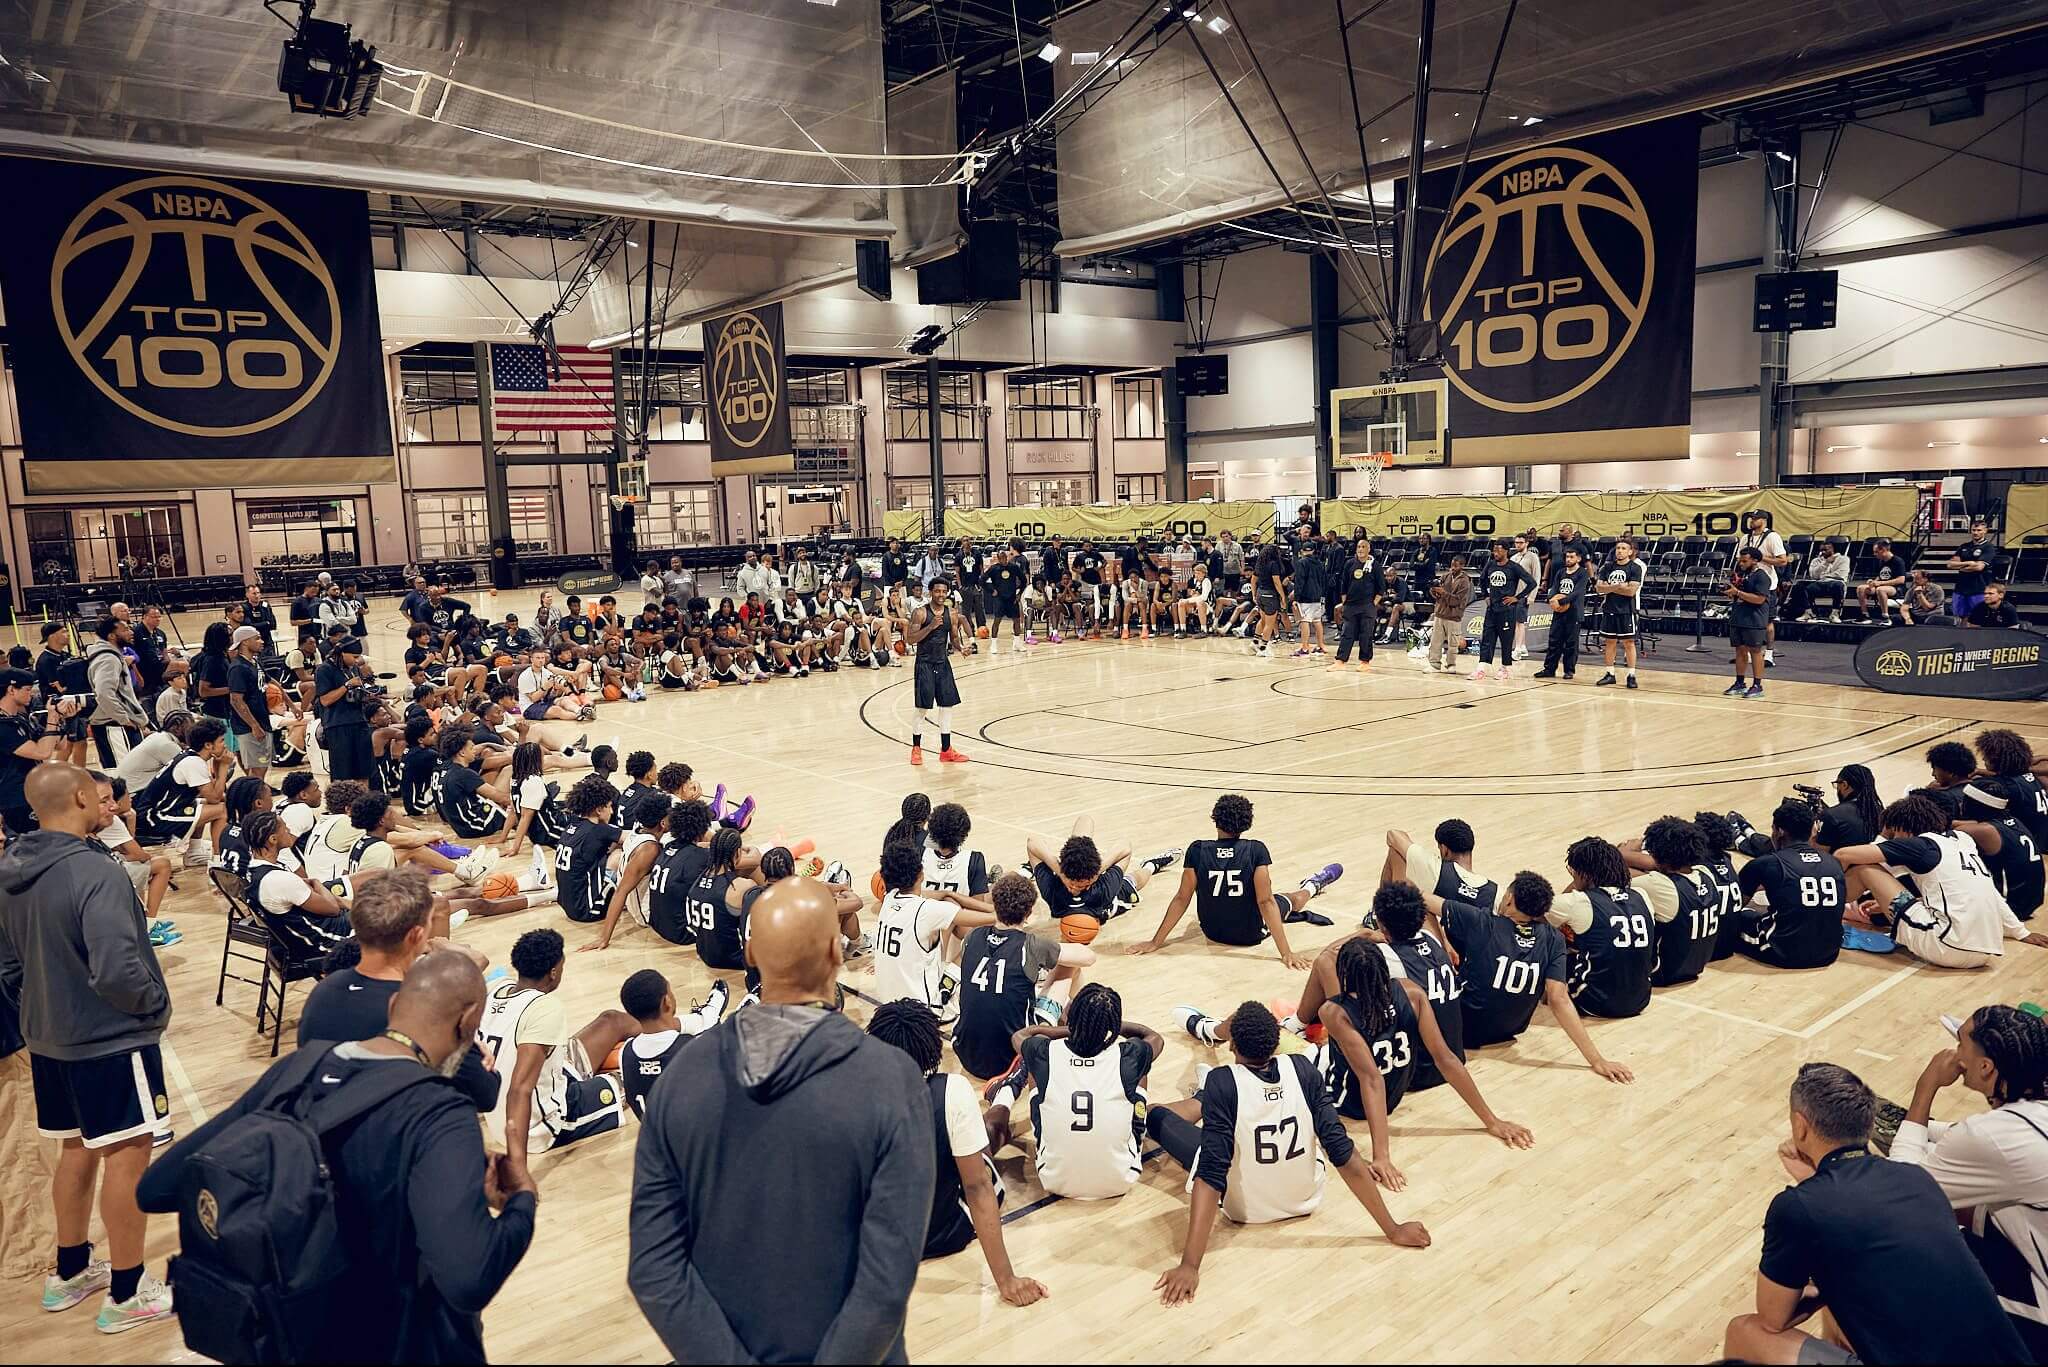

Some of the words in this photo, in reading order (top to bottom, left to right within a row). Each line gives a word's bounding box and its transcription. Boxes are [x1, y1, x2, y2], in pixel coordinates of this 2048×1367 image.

[1502, 164, 1565, 196] NBPA
[152, 193, 232, 219] NBPA
[1474, 276, 1583, 313] TOP
[129, 305, 268, 333] TOP
[732, 321, 751, 337] NBPA
[1450, 304, 1610, 371] 100
[102, 335, 303, 390] 100
[728, 378, 760, 396] TOP
[1377, 387, 1397, 395] NBPA
[723, 392, 768, 425] 100
[1013, 522, 1046, 536] 100
[1386, 524, 1434, 536] TOP
[1436, 515, 1496, 535] 100
[1400, 515, 1419, 523] NBPA
[1624, 522, 1688, 536] TOP
[1642, 513, 1669, 521] NBPA
[1917, 653, 1954, 677] THIS
[1953, 662, 1961, 673] IT
[1962, 661, 1976, 673] ALL
[1954, 652, 1963, 662] IS
[1964, 649, 1992, 661] WHERE
[1992, 646, 2040, 665] BEGINS
[649, 864, 670, 893] 31
[1208, 869, 1244, 897] 75
[1800, 876, 1838, 906] 89
[1717, 881, 1743, 915] 79
[1609, 914, 1649, 948] 39
[1689, 903, 1719, 940] 115
[876, 920, 903, 957] 116
[970, 956, 1006, 994] 41
[1427, 963, 1468, 1004] 42
[1492, 955, 1540, 995] 101
[1070, 1058, 1095, 1067] 100
[1372, 1030, 1411, 1075] 33
[1070, 1090, 1093, 1131] 9
[1254, 1115, 1306, 1164] 62
